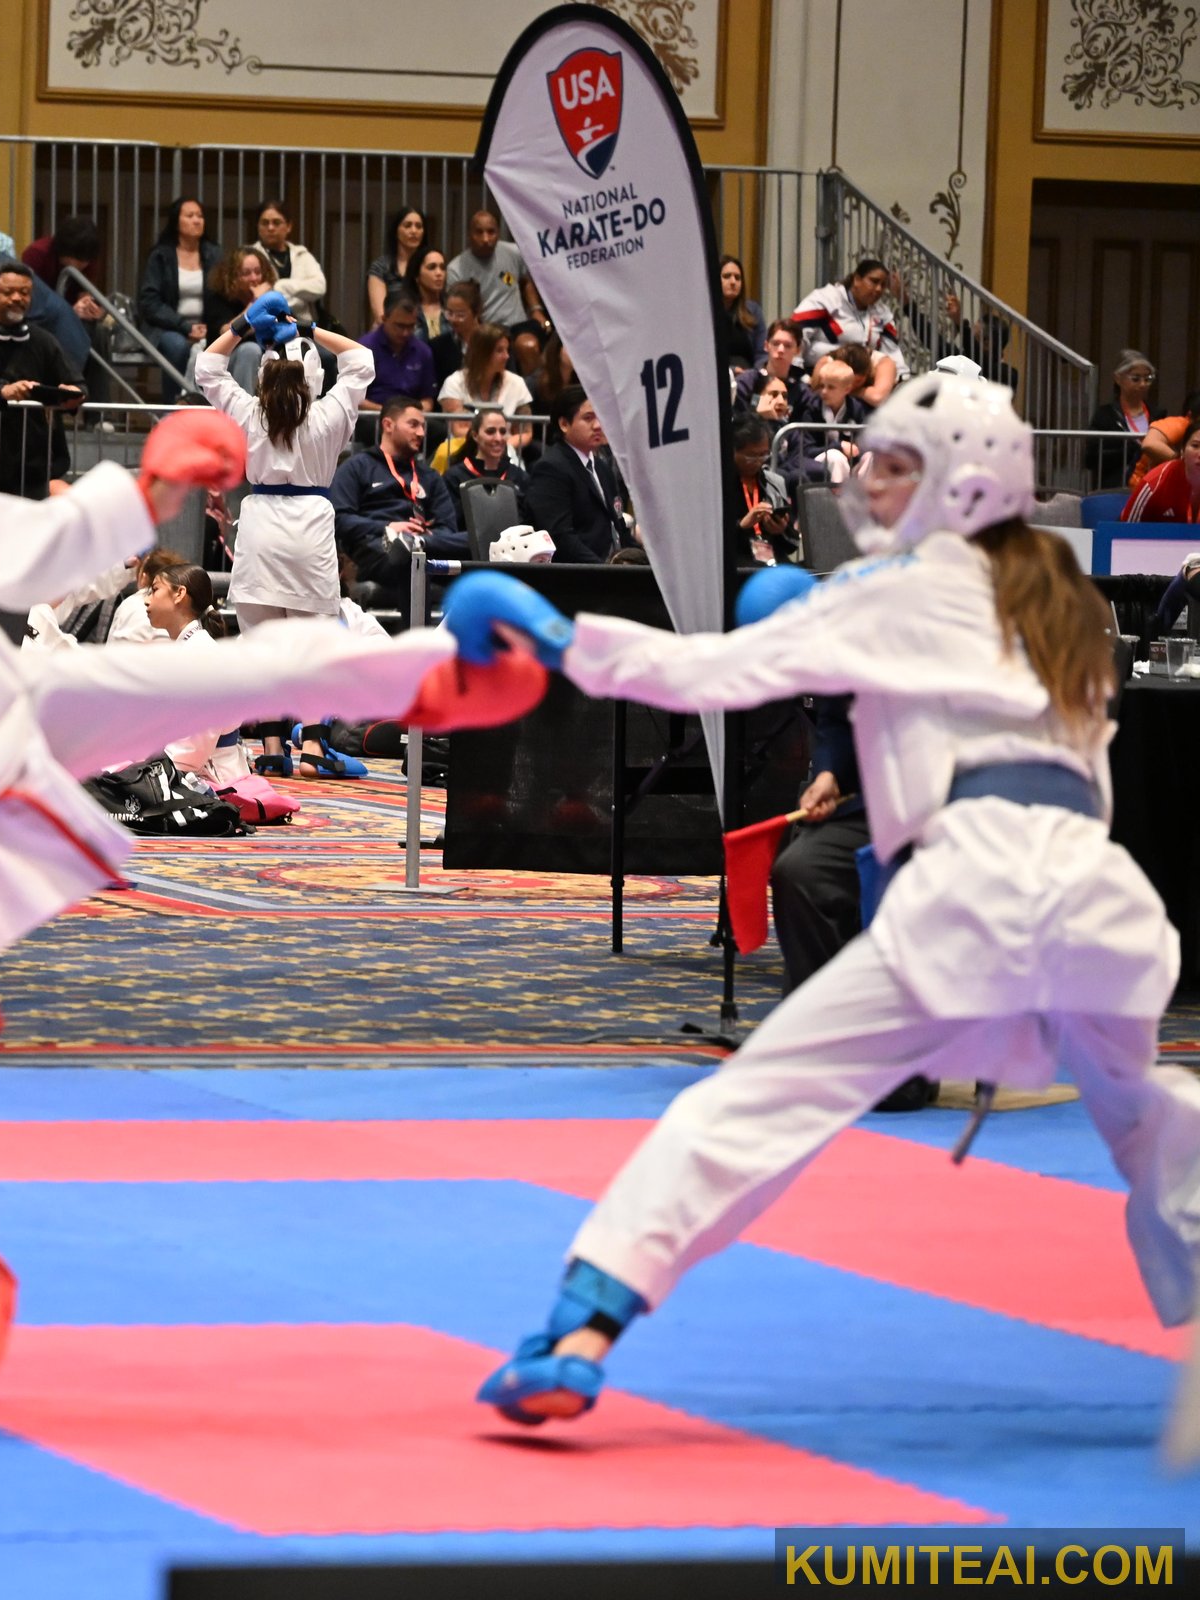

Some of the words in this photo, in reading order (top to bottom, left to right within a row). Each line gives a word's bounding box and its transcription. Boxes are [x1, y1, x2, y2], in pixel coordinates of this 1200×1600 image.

[558, 65, 616, 110] USA
[562, 182, 638, 219] NATIONAL
[537, 197, 666, 258] KARATE-DO
[566, 235, 645, 270] FEDERATION
[640, 353, 690, 449] 12
